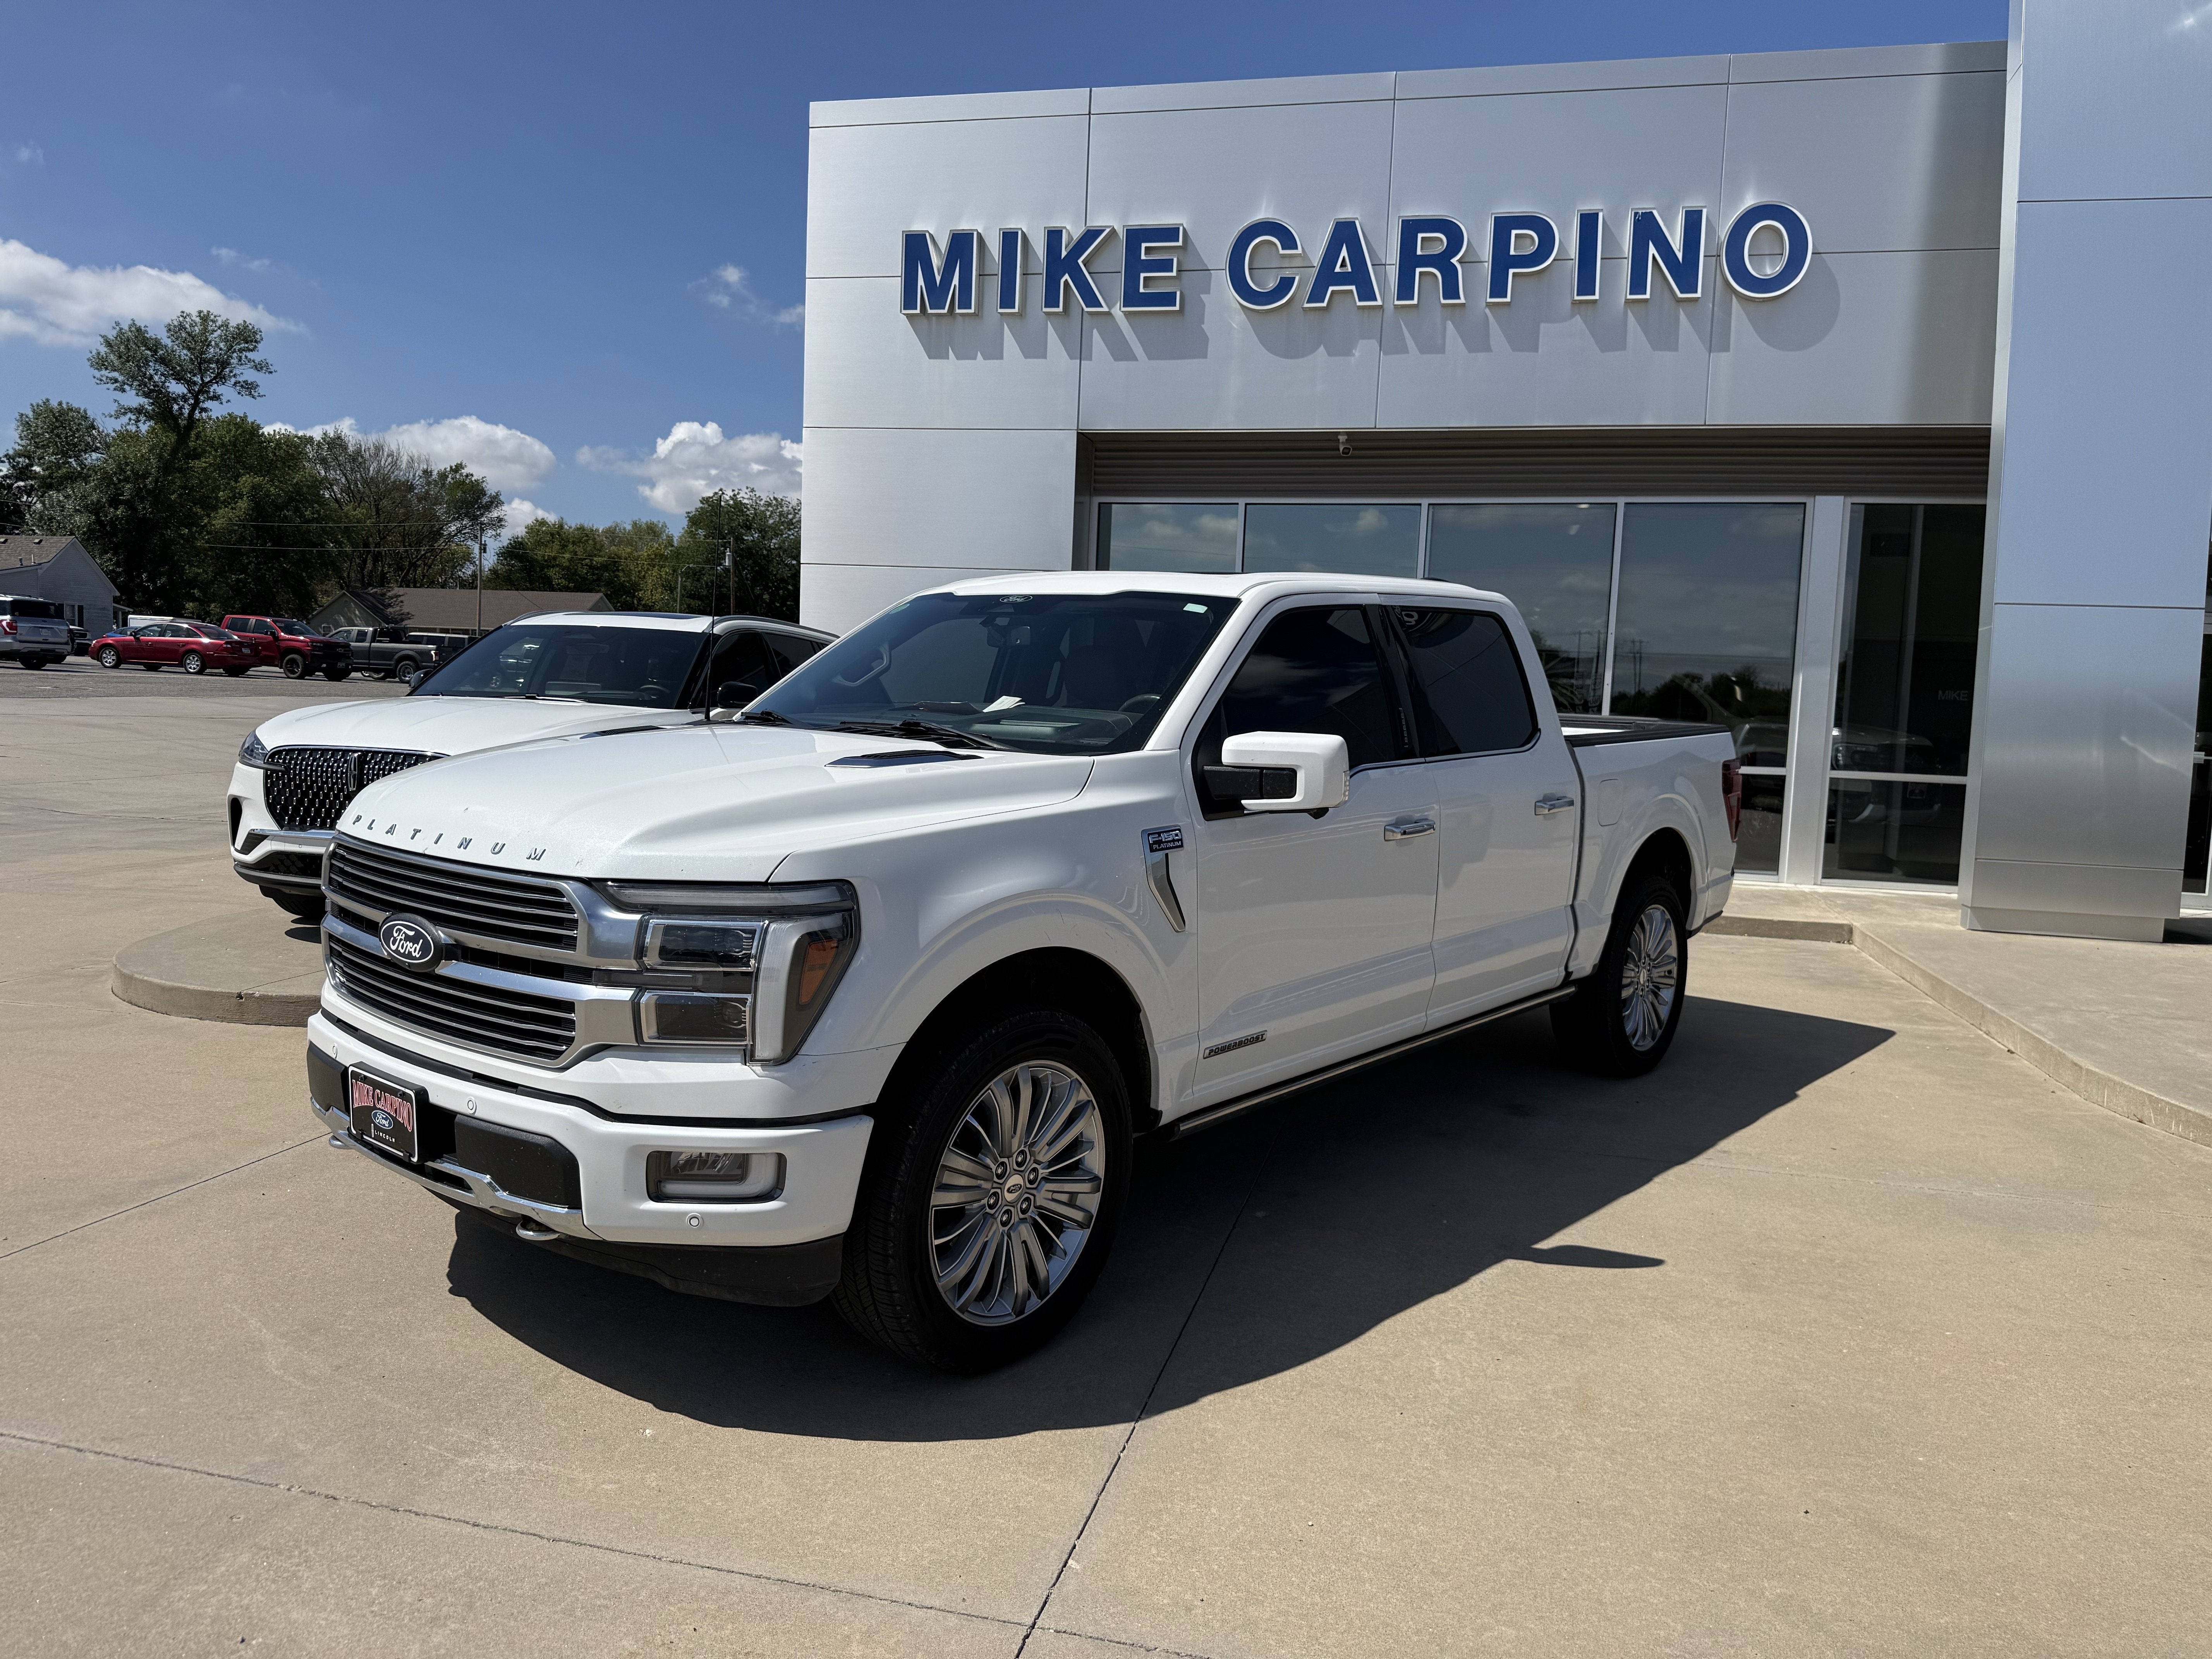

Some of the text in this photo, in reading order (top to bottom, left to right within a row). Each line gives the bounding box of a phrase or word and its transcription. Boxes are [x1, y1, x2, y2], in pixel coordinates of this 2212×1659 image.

[900, 201, 1813, 315] MIKE CARPINO
[1938, 690, 1968, 701] MIKE
[352, 814, 546, 861] PLATINUM
[1149, 831, 1182, 843] F-150
[1153, 841, 1181, 849] PLATINUM
[390, 926, 423, 958] Ford
[1208, 1033, 1266, 1056] POWERBOOST
[352, 1080, 412, 1132] MIKE CARPINO
[376, 1112, 389, 1127] Ford
[375, 1130, 395, 1142] LINCOLN
